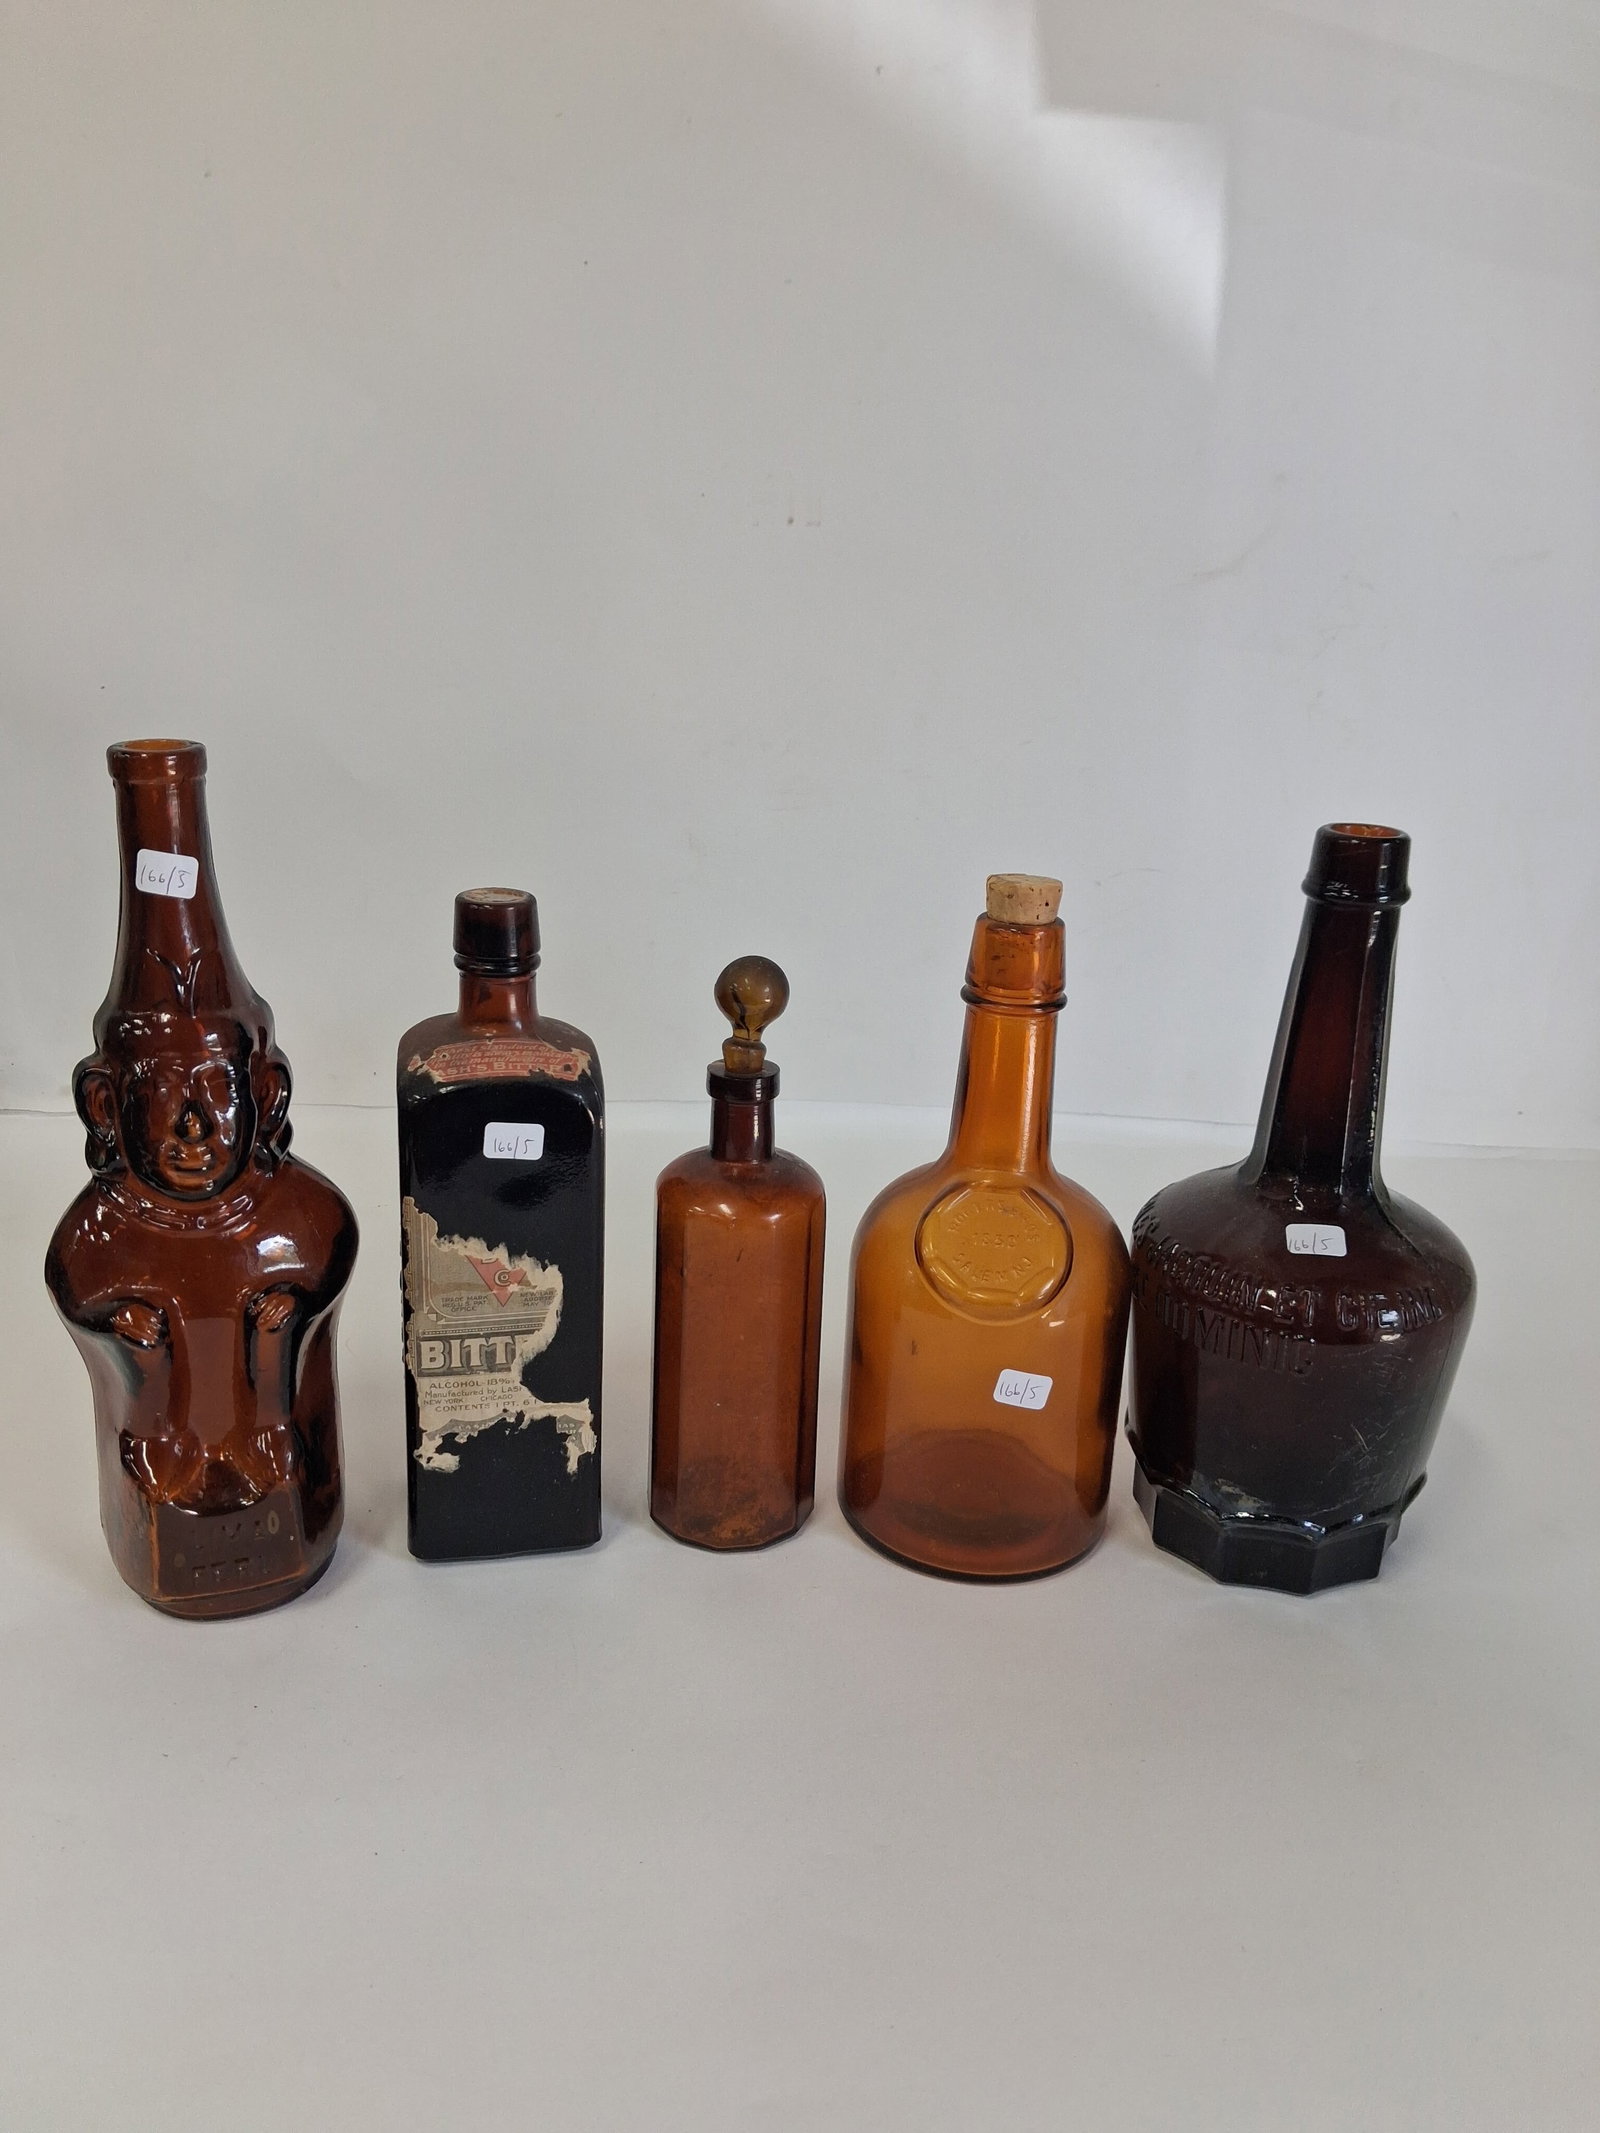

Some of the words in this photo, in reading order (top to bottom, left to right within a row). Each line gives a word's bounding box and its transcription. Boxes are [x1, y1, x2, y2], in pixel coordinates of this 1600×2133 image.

[140, 864, 192, 895] 166/5
[494, 1136, 535, 1159] 166/5
[1289, 1232, 1335, 1254] 166/5
[421, 1335, 514, 1370] BITT
[425, 1388, 484, 1399] Manufactured
[487, 1387, 498, 1395] by
[480, 1393, 513, 1402] CHICAGO
[1000, 1378, 1044, 1404] 166/5
[435, 1403, 491, 1412] CONTENTS
